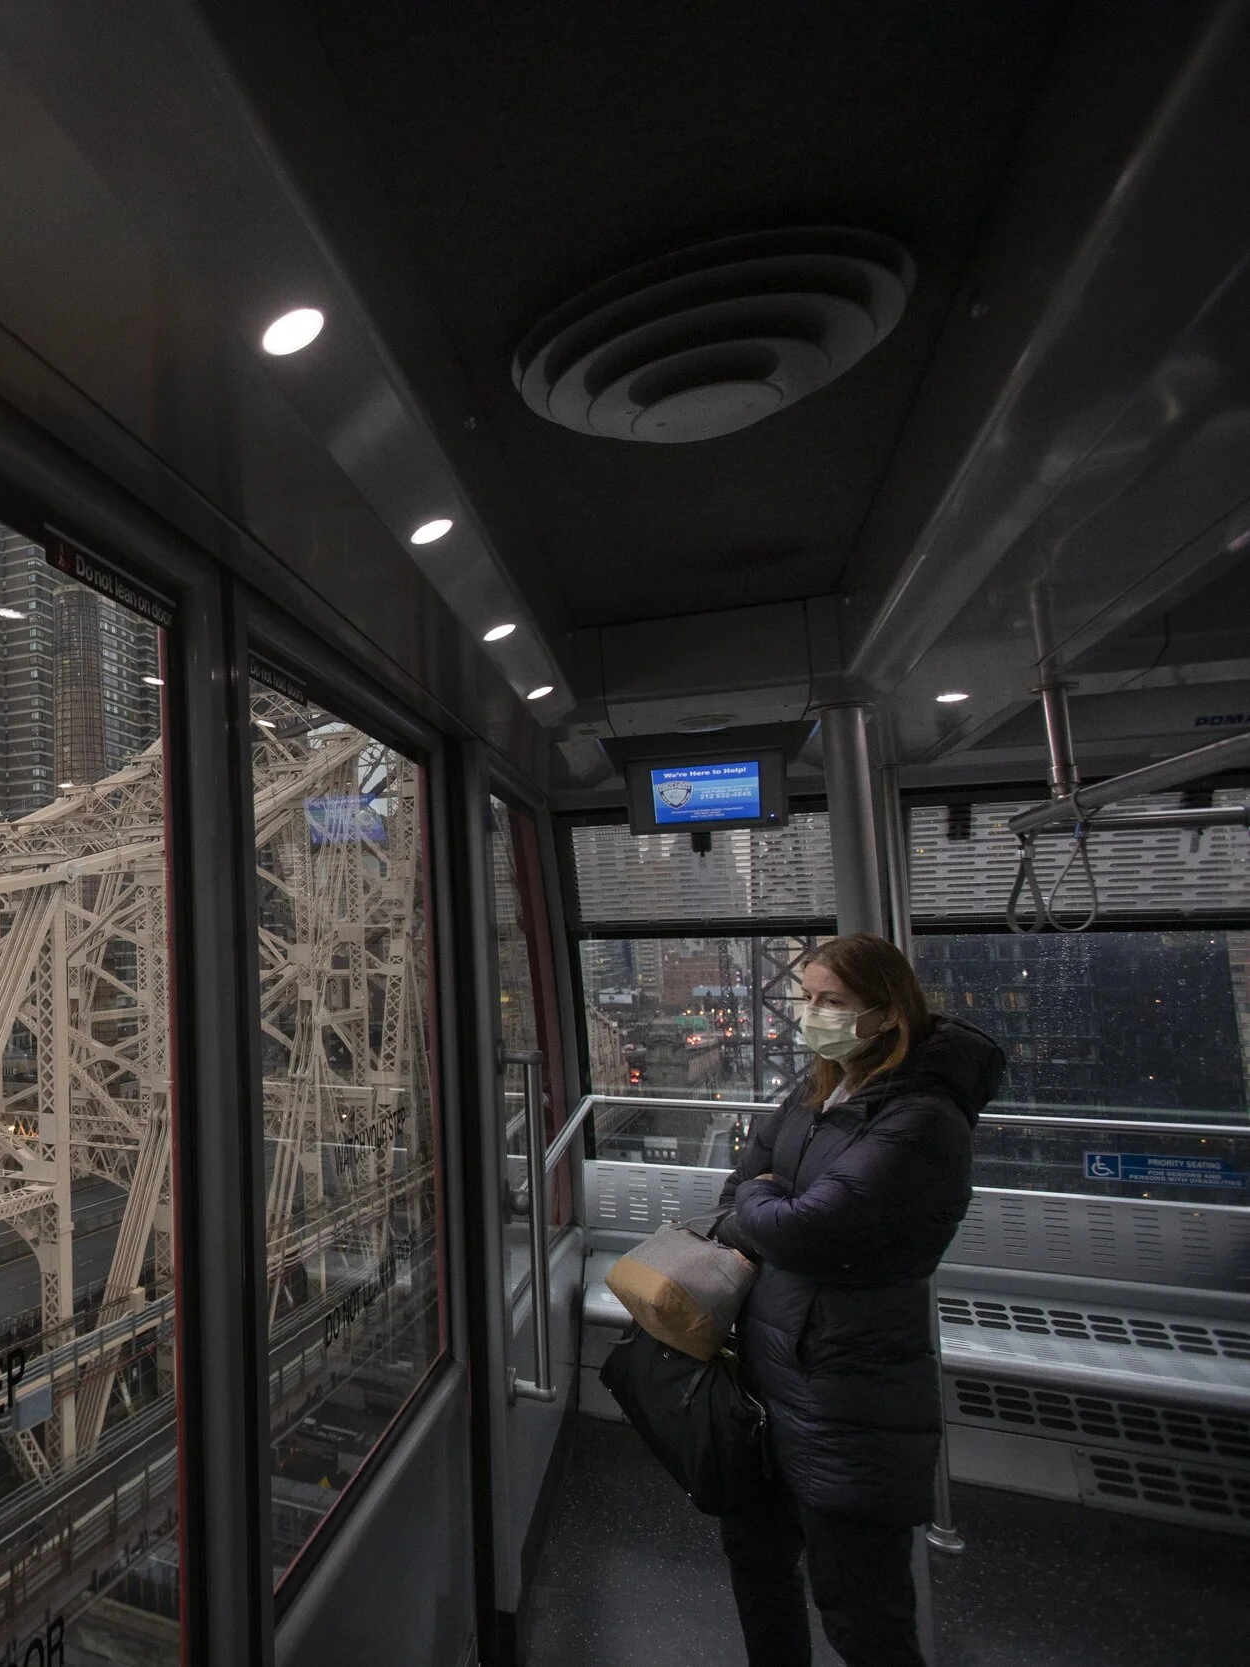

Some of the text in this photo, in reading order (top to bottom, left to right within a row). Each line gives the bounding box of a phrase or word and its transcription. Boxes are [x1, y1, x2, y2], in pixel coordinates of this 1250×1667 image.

[75, 553, 93, 581] Do
[95, 569, 113, 594] not
[115, 576, 137, 607] lean
[139, 596, 150, 616] on
[250, 658, 260, 677] Do
[261, 668, 272, 686] not
[663, 771, 687, 779] We're
[723, 766, 746, 774] Help!
[1147, 1158, 1222, 1170] PRIORITY SEATING
[1129, 1174, 1166, 1182] PERSONS
[1189, 1178, 1242, 1187] DISABILITIES
[325, 1308, 340, 1348] DO
[342, 1285, 361, 1332] NOT
[7, 1615, 65, 1667] OR
